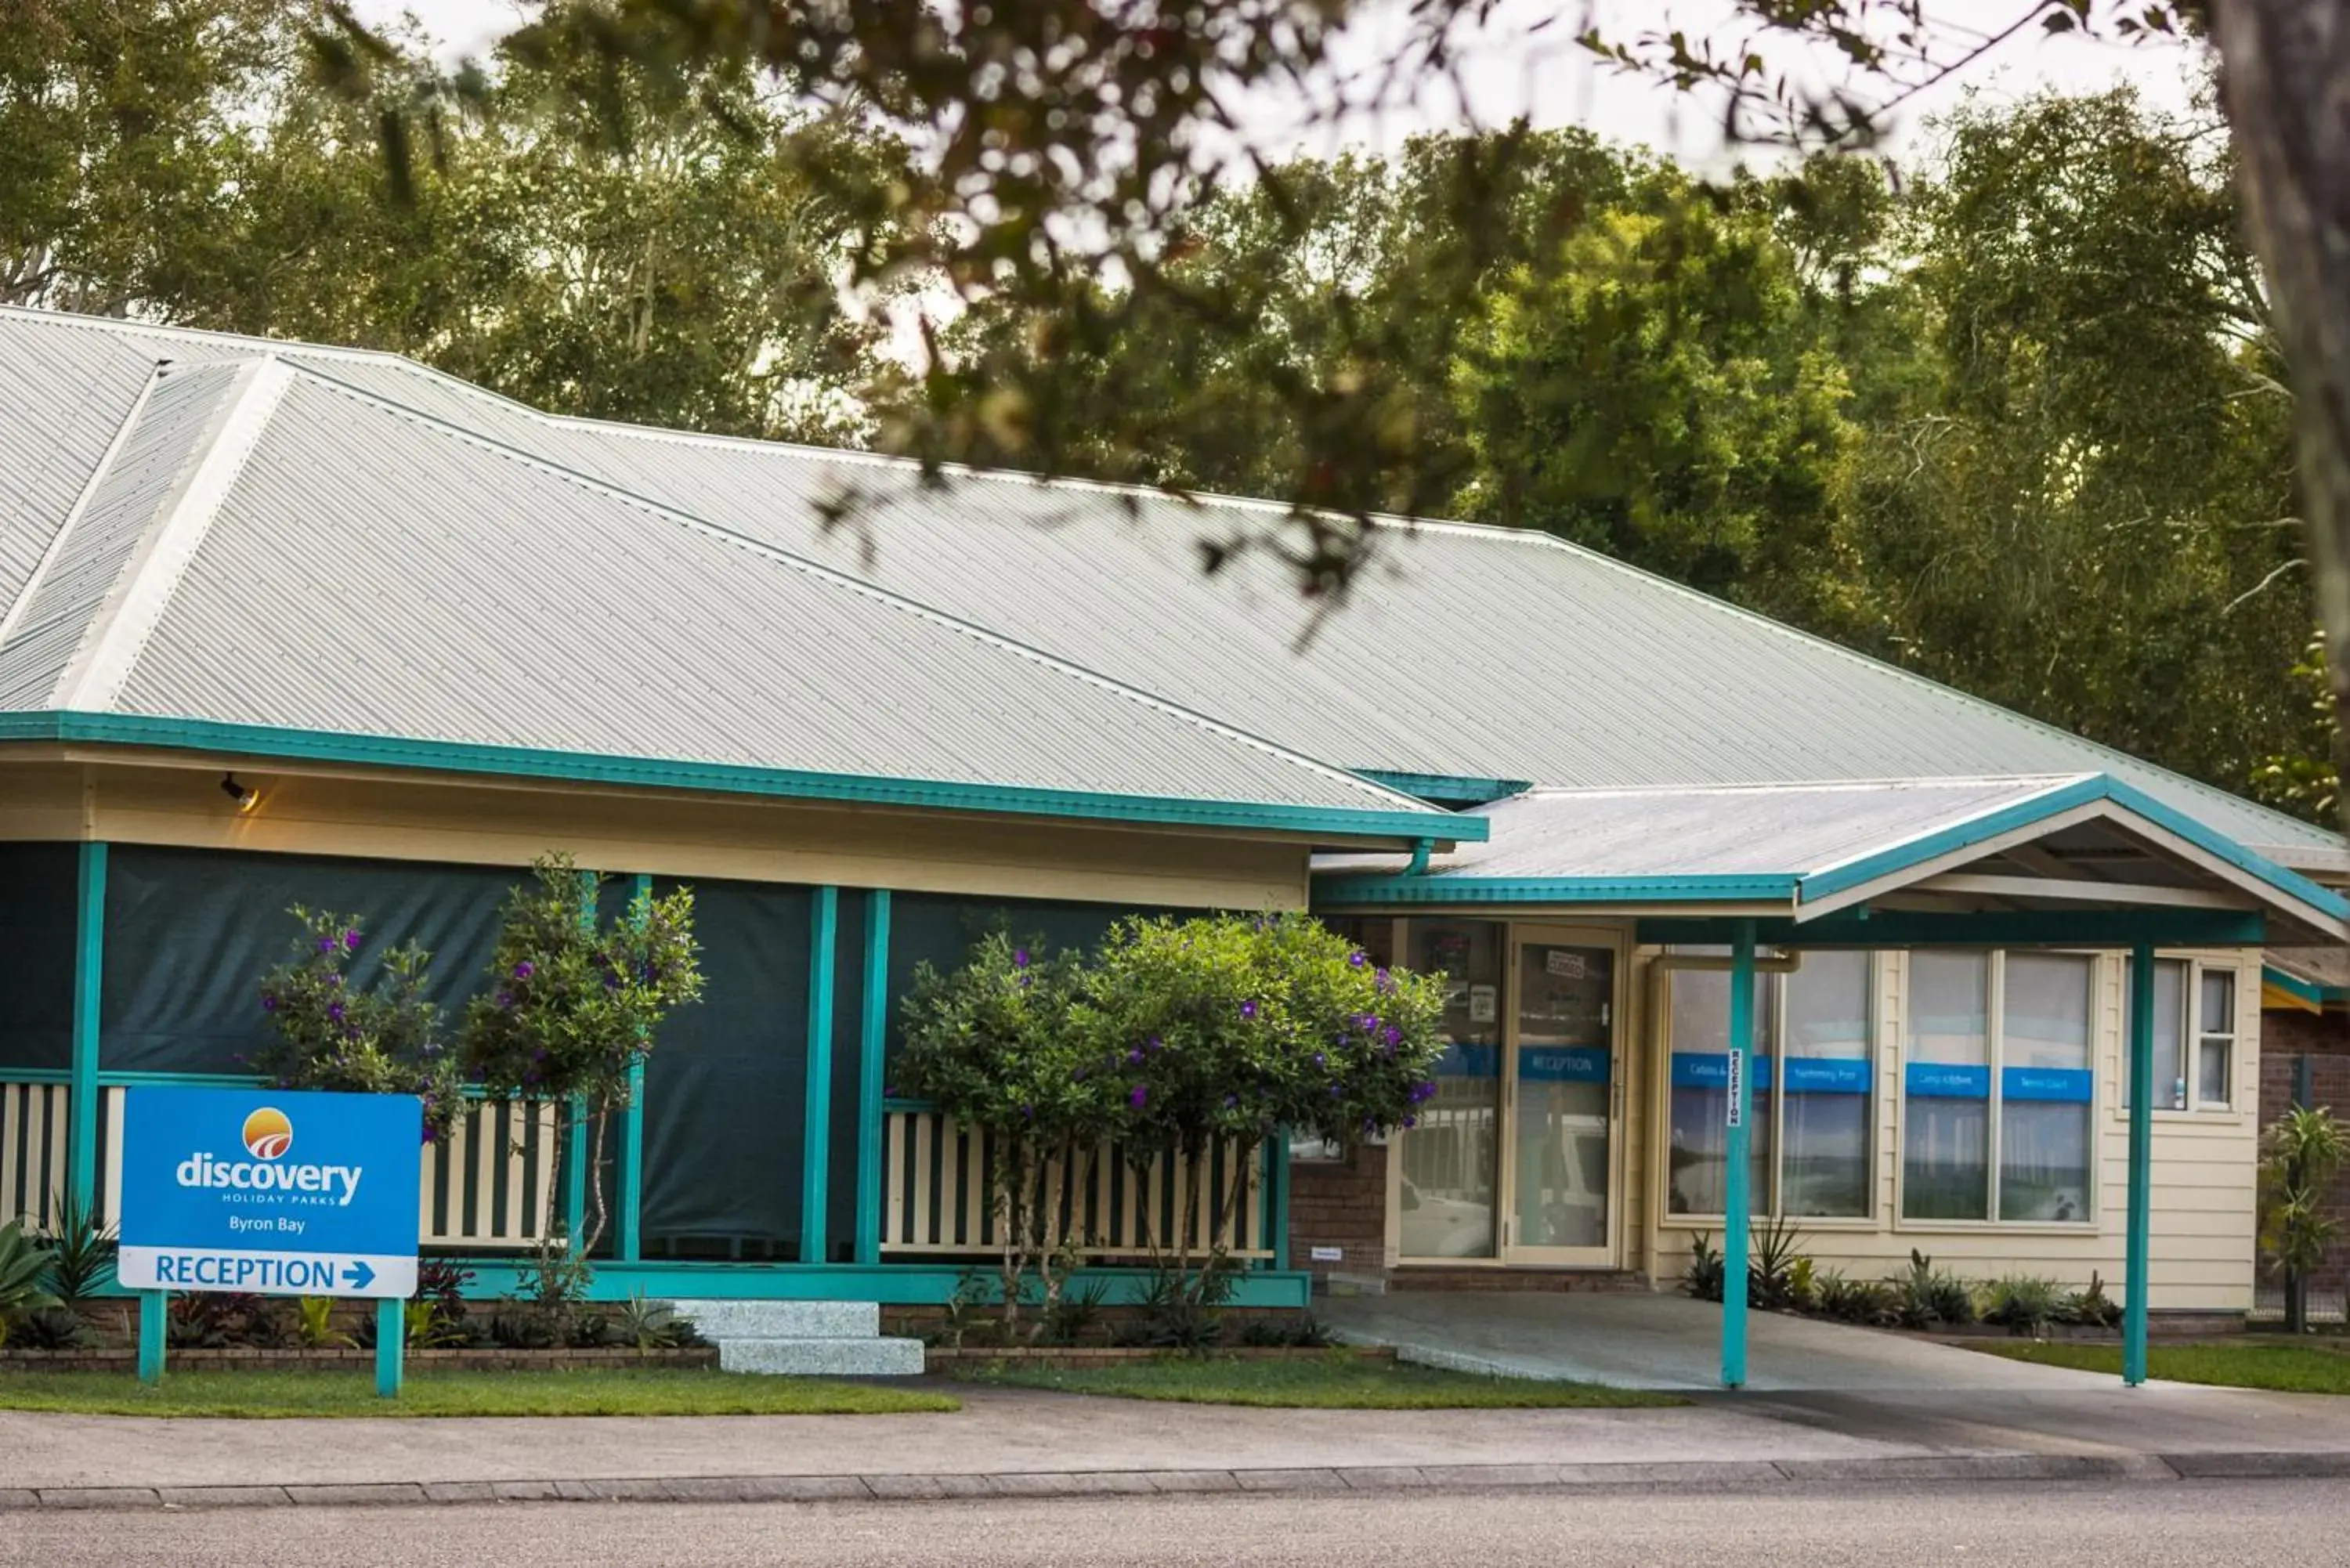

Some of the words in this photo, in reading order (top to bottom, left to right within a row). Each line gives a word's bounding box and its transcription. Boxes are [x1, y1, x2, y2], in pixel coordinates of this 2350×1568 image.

[1533, 1055, 1593, 1072] RECEPTION
[1730, 1050, 1740, 1125] RECEPTION
[176, 1152, 363, 1206] discovery
[222, 1193, 284, 1204] HOLIDAY
[291, 1195, 335, 1206] PARKS
[229, 1216, 273, 1234] Byron
[278, 1217, 306, 1235] Bay
[157, 1255, 334, 1288] RECEPTION
